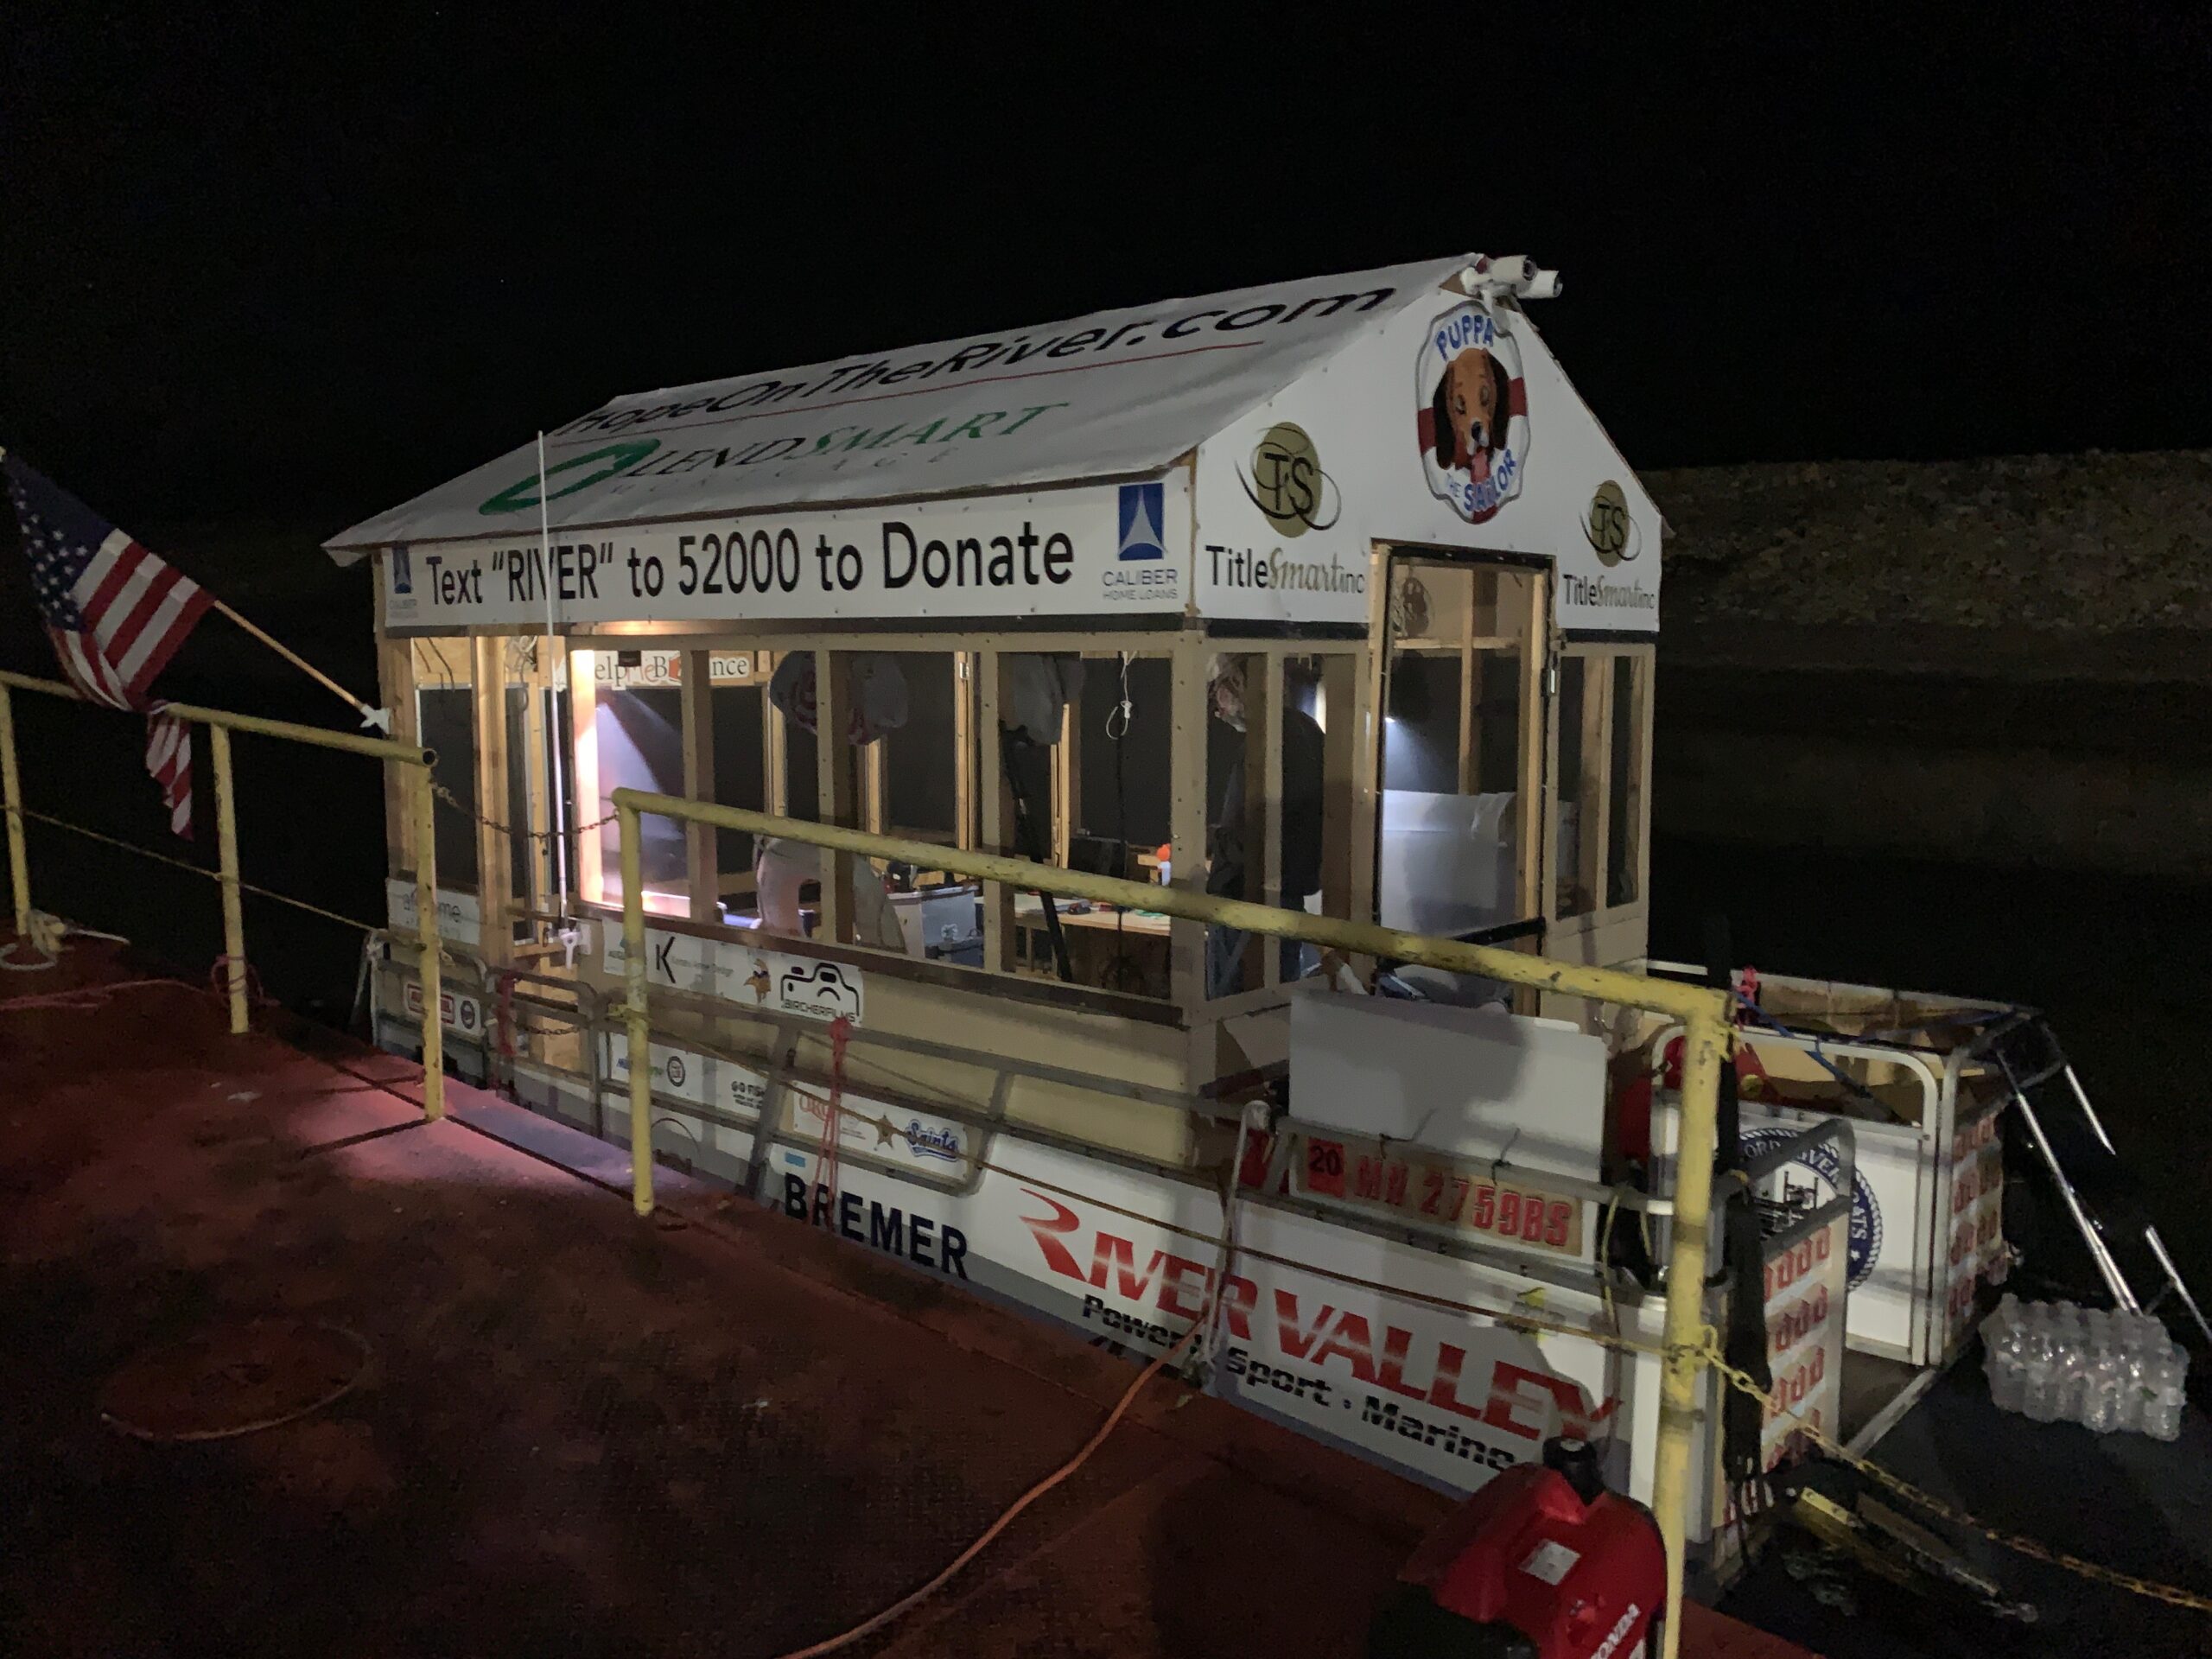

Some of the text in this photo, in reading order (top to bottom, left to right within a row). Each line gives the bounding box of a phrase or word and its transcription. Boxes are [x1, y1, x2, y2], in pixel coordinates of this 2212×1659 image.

[1435, 314, 1495, 361] PUPPA
[622, 403, 1070, 477] LENDSMART
[1464, 448, 1517, 512] SAILOR
[426, 555, 481, 605] Text
[626, 547, 664, 597] to
[678, 528, 800, 595] 52000
[816, 534, 862, 591] to
[882, 521, 1074, 588] Donate
[1103, 569, 1179, 587] CALIBER
[1309, 1145, 1340, 1177] 20
[785, 1172, 968, 1281] BREMER
[1226, 1346, 1332, 1408] Sport
